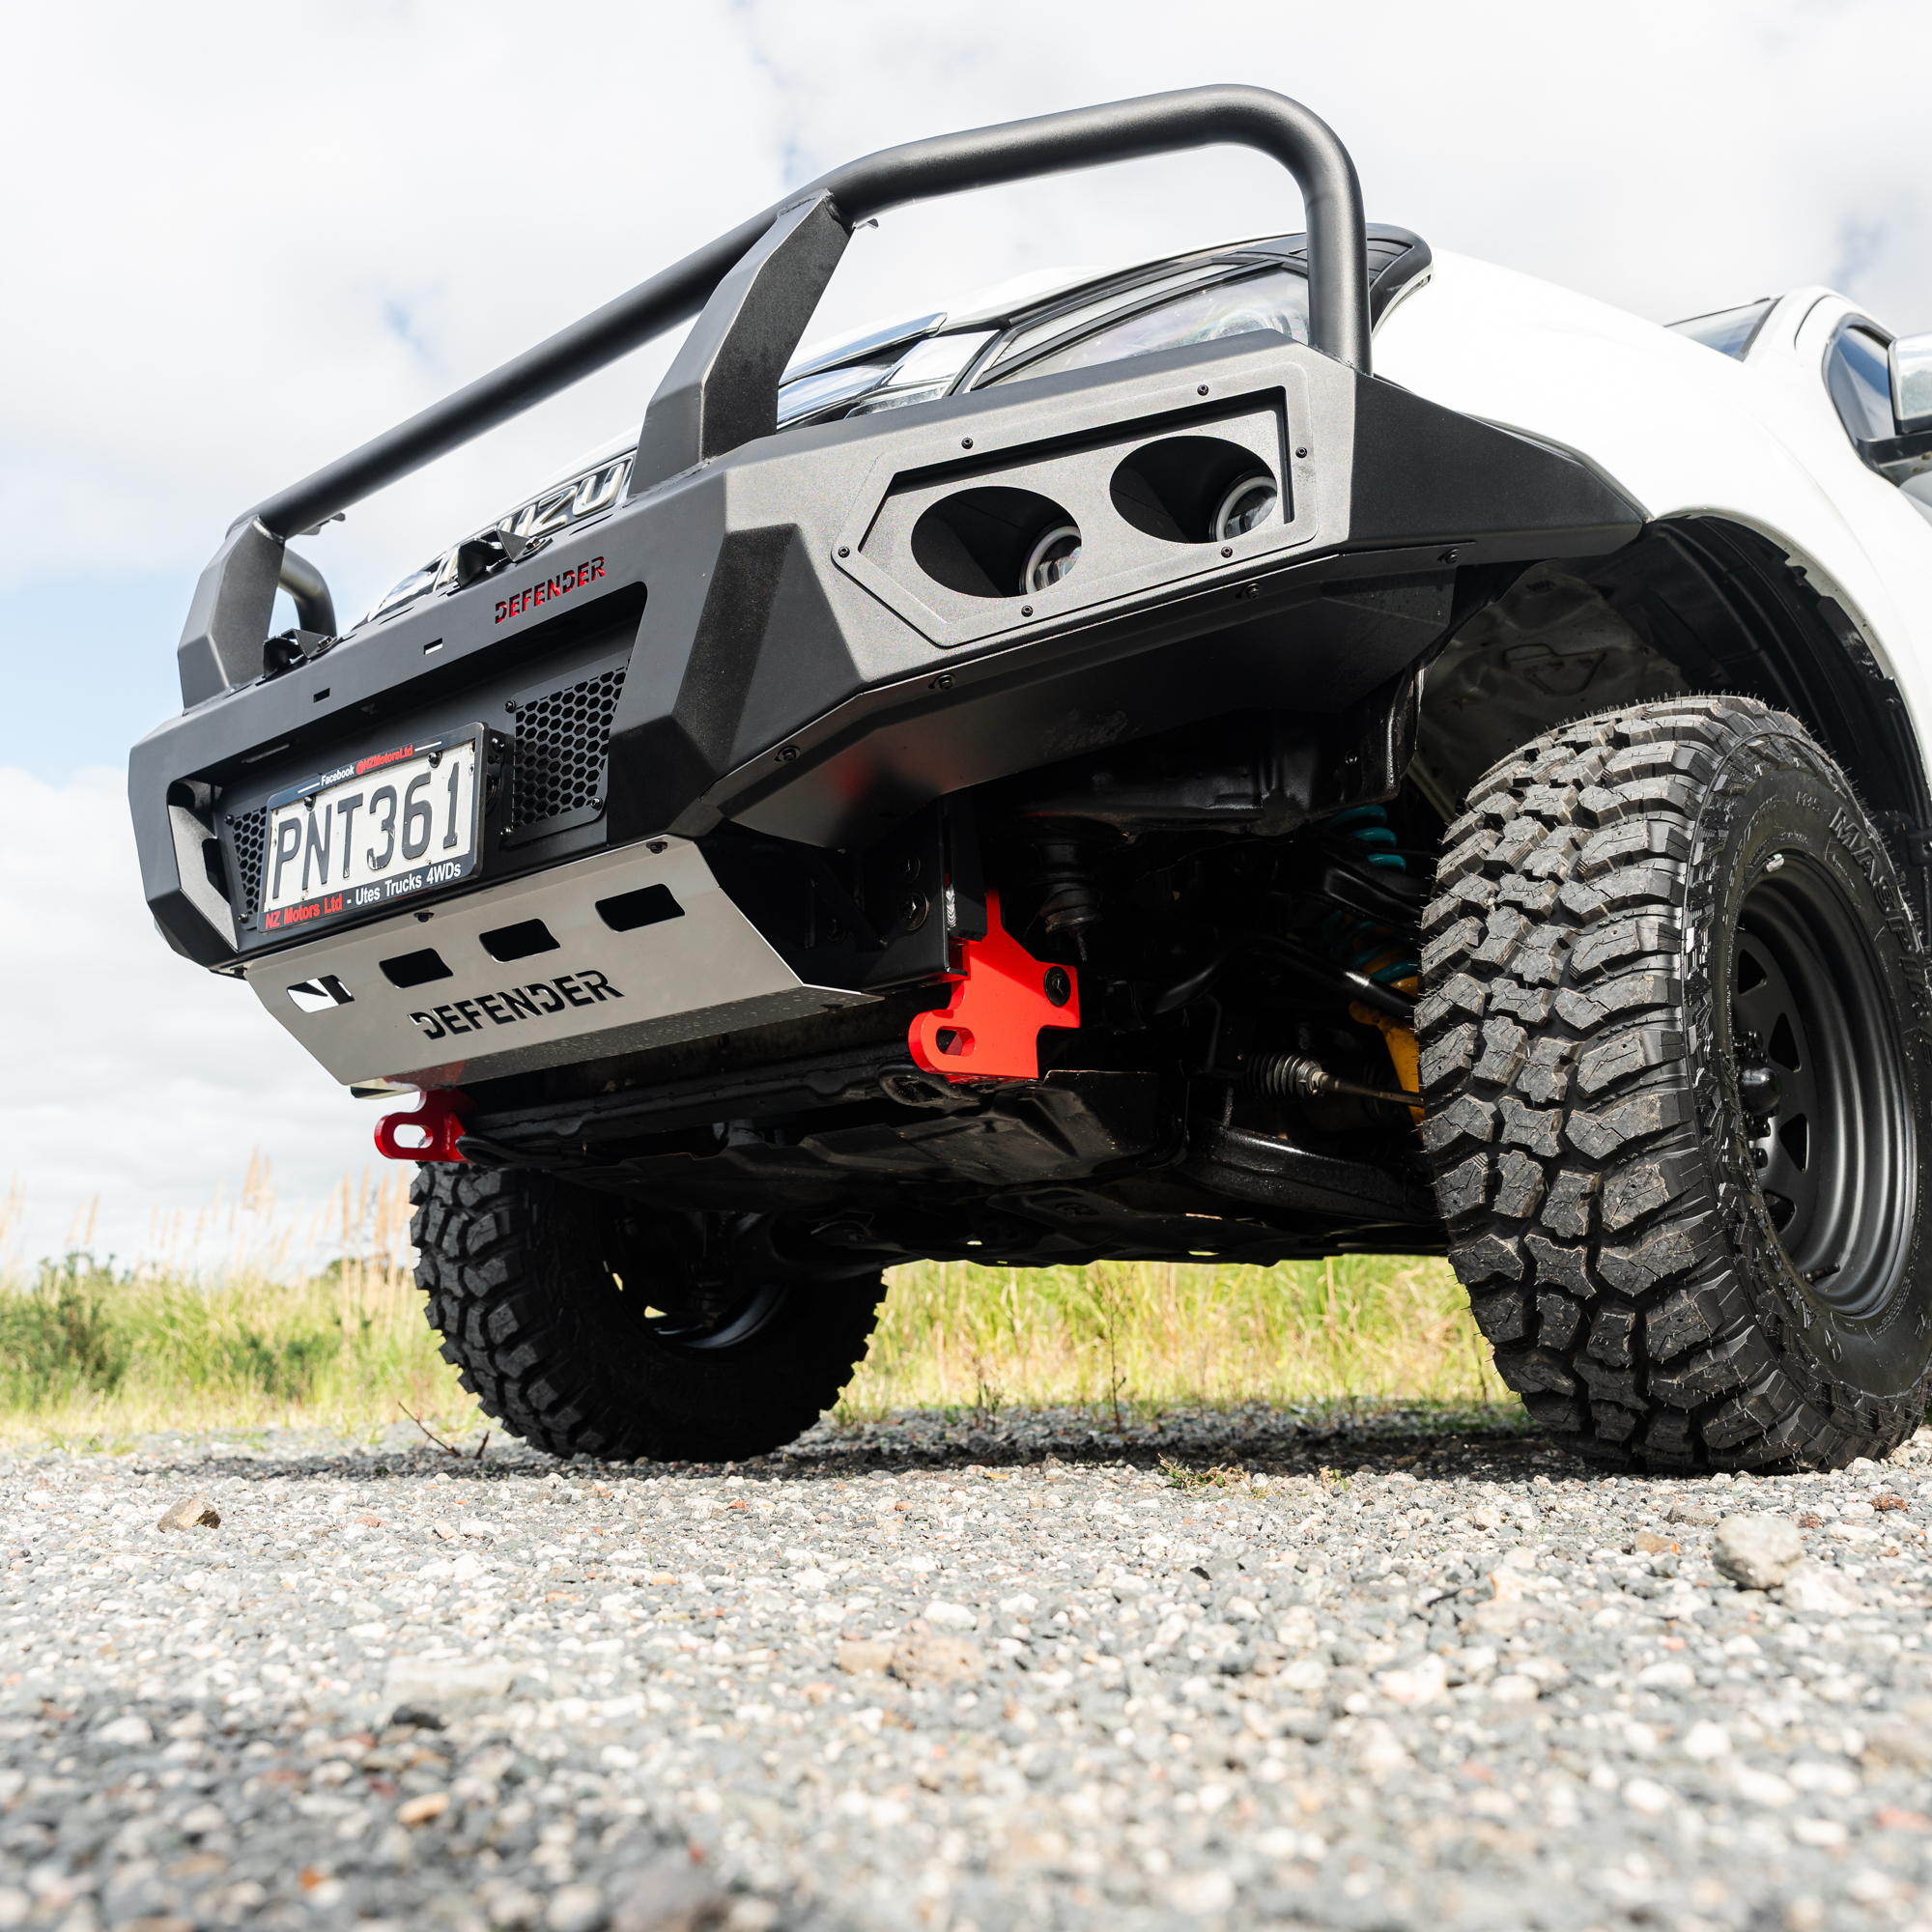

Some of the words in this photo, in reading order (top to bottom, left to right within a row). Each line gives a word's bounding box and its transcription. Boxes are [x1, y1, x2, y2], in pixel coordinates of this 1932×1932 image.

[495, 555, 606, 624] DEFENDER
[321, 765, 355, 786] Facebook
[355, 745, 413, 775] @NZMotorsLtd
[272, 761, 461, 900] PNT361
[265, 911, 281, 929] NZ
[283, 903, 321, 924] Motors
[324, 893, 343, 914] Ltd
[355, 887, 381, 905] Utes
[384, 873, 422, 897] Trucks
[426, 862, 462, 885] 4WDs
[407, 969, 626, 1040] DEFENDER
